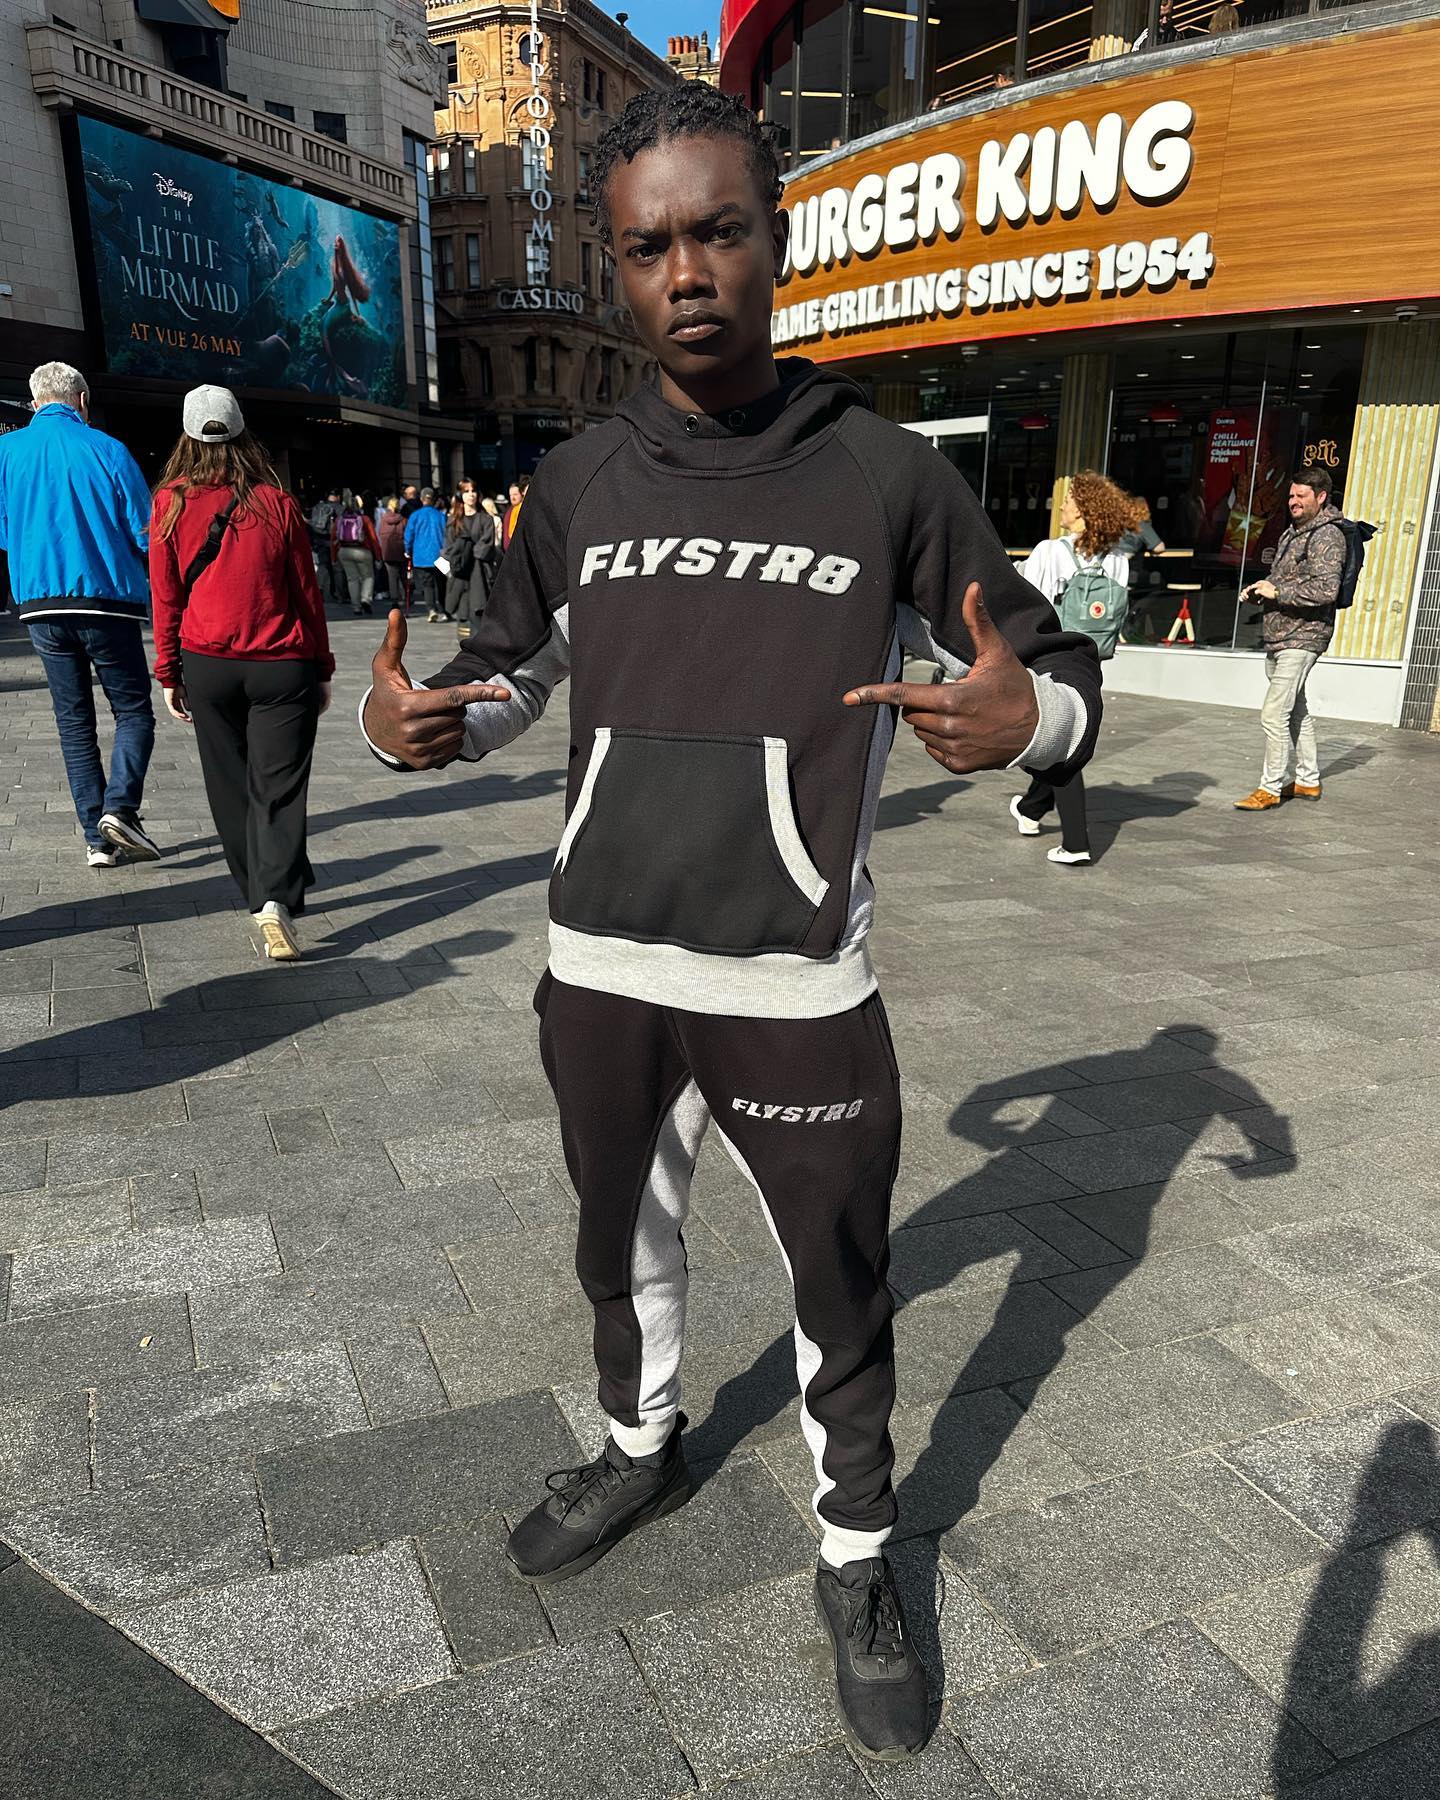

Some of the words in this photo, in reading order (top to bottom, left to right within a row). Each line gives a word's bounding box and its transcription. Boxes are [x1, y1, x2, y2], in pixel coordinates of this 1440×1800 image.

[526, 0, 554, 273] IPPODROME
[152, 172, 193, 207] Disney
[781, 151, 961, 277] URGER
[975, 100, 1194, 227] KING
[137, 215, 223, 271] LITTLE
[120, 255, 239, 321] MERMAID
[497, 287, 584, 315] CASINO
[771, 298, 821, 344] AME
[821, 267, 963, 332] GRILLING
[966, 248, 1090, 308] SINCE
[1096, 231, 1215, 290] 1954
[130, 322, 151, 342] AT
[155, 326, 188, 349] VUE
[191, 332, 208, 352] 26
[210, 335, 242, 357] MAY
[1210, 448, 1241, 457] Chicken
[1211, 439, 1256, 448] HEATWAVE
[1212, 432, 1239, 440] CHILLI
[1209, 455, 1230, 464] Fries
[578, 536, 862, 597] FLYSTR8
[731, 1097, 864, 1124] FLYSTR8
